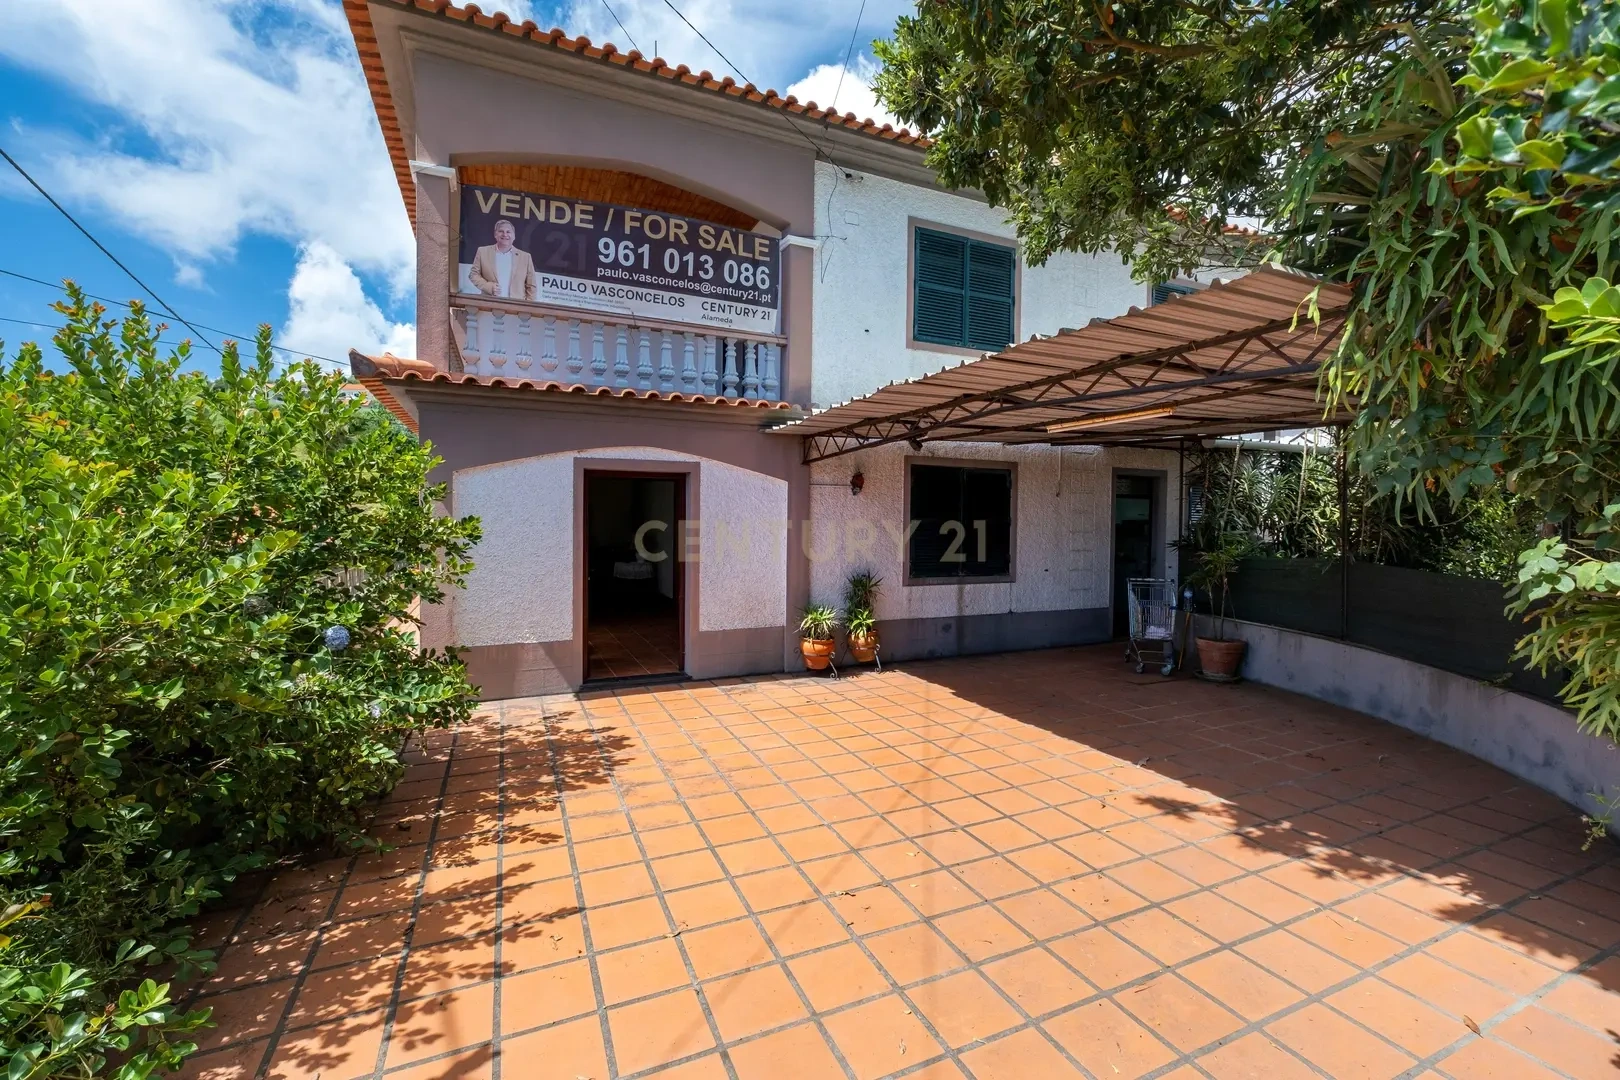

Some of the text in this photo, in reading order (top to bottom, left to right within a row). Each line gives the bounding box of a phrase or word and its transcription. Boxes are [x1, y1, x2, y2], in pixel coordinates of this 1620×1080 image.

[474, 189, 771, 262] VENDE / FOR SALE
[598, 237, 770, 290] 961 013 086
[542, 277, 587, 293] PAULO
[590, 284, 686, 308] VASCONCELOS
[597, 266, 772, 303] paulo.vasconcelos@century21.pt
[701, 301, 771, 321] CENTURY 21
[701, 313, 733, 324] Alameda
